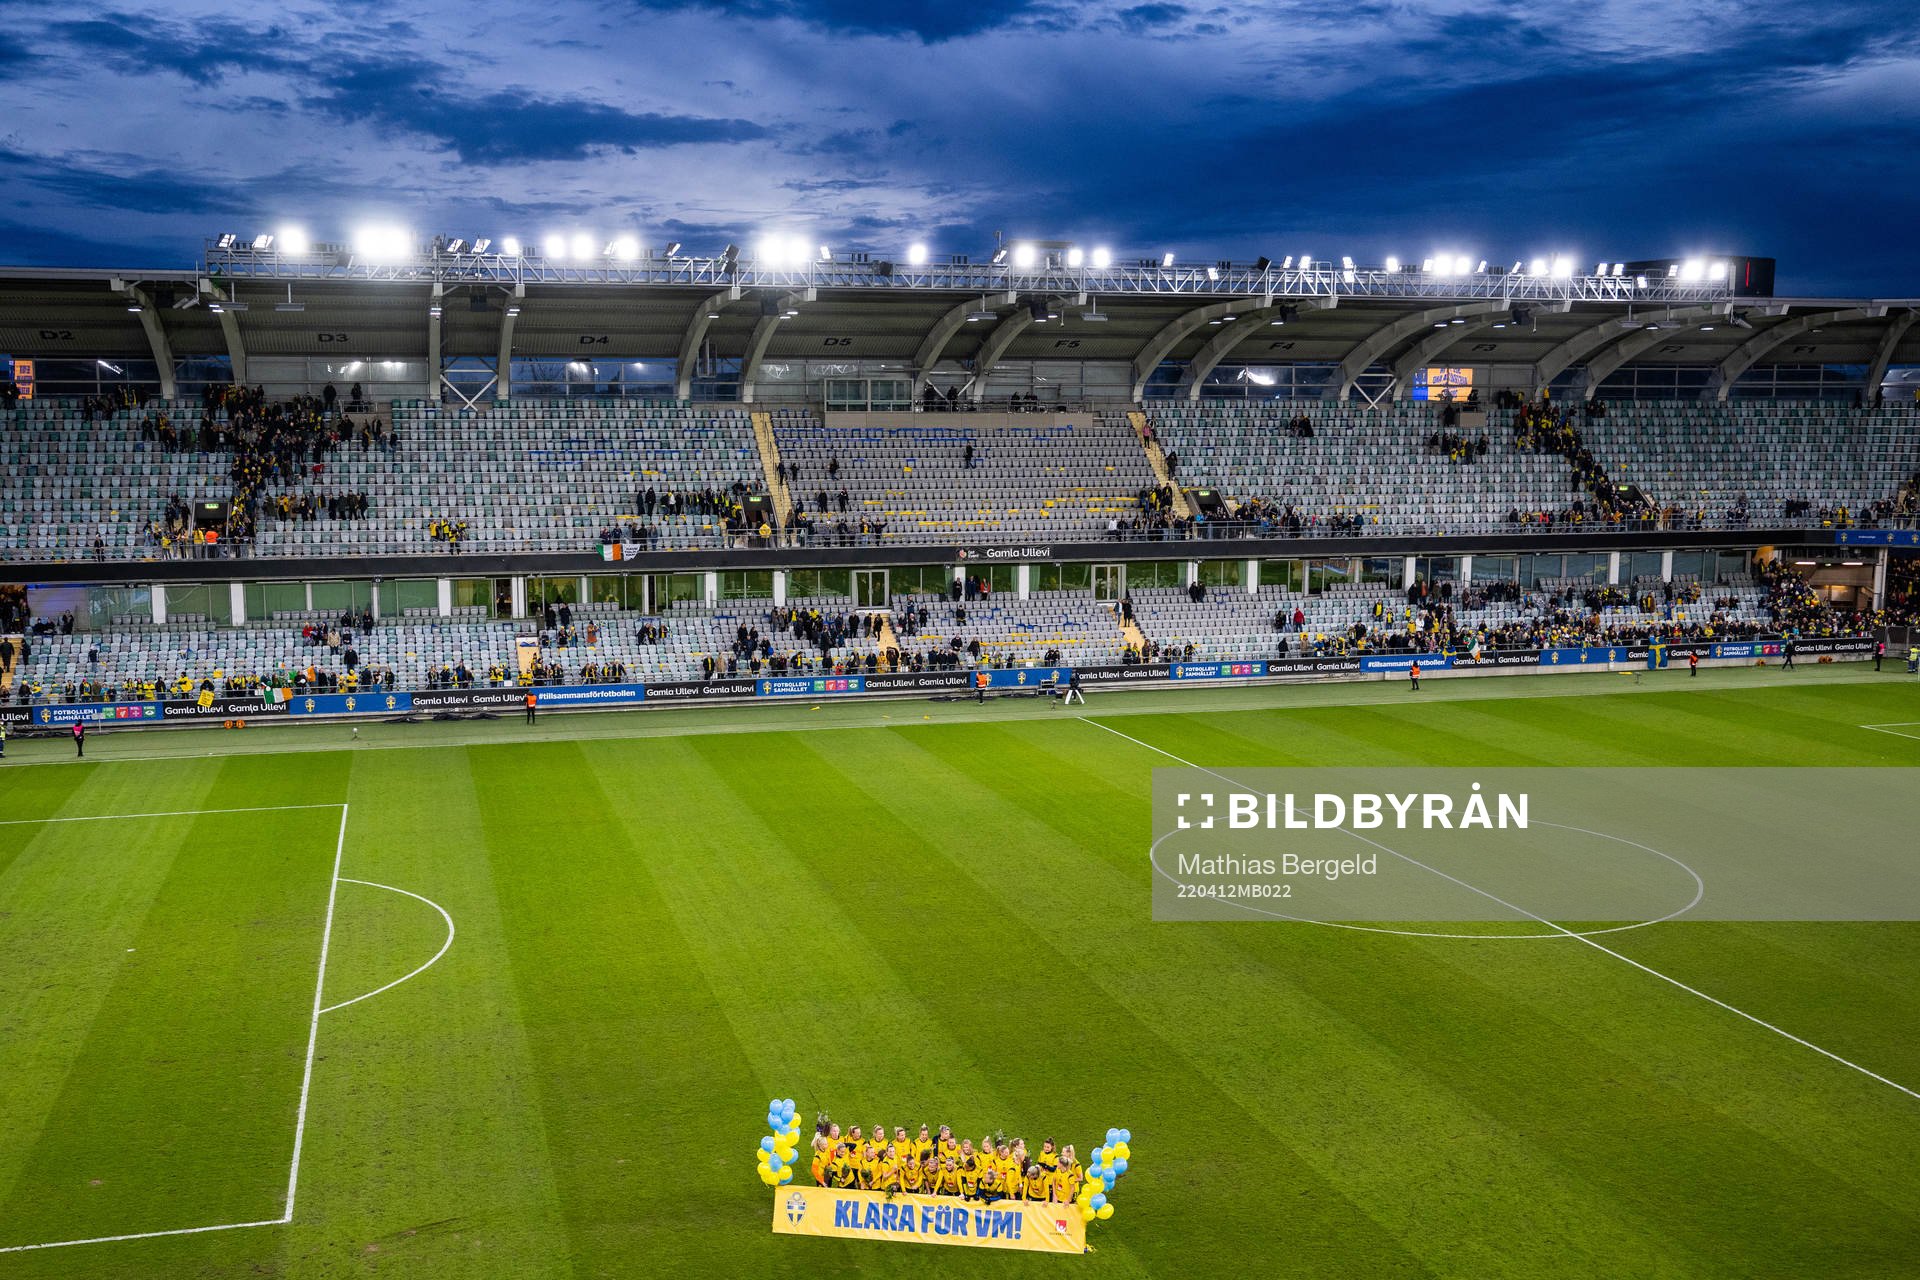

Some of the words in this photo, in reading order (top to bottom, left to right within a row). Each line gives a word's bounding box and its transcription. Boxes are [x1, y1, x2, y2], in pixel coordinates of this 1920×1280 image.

[318, 333, 348, 342] D3
[580, 335, 608, 344] D4
[986, 548, 1019, 558] Gamla
[1022, 548, 1050, 556] Ullevi
[1270, 664, 1292, 672] Gamla
[1294, 663, 1314, 671] Ullevi
[1341, 661, 1360, 669] Ullevi
[1099, 671, 1120, 679] Ullevi
[1124, 670, 1147, 678] Gamla
[1148, 668, 1169, 677] Ullevi
[866, 680, 892, 688] Gamla
[893, 679, 914, 687] Ullevi
[946, 676, 967, 685] Ullevi
[538, 690, 636, 700] #tillsammansförfotbollen
[646, 688, 674, 696] Gamla
[198, 705, 224, 714] Ullevi
[228, 704, 258, 713] Gamla
[2, 712, 29, 721] Ullevi
[834, 1200, 915, 1232] KLARA
[921, 1206, 968, 1236] FÖR
[974, 1210, 1022, 1240] VM!
